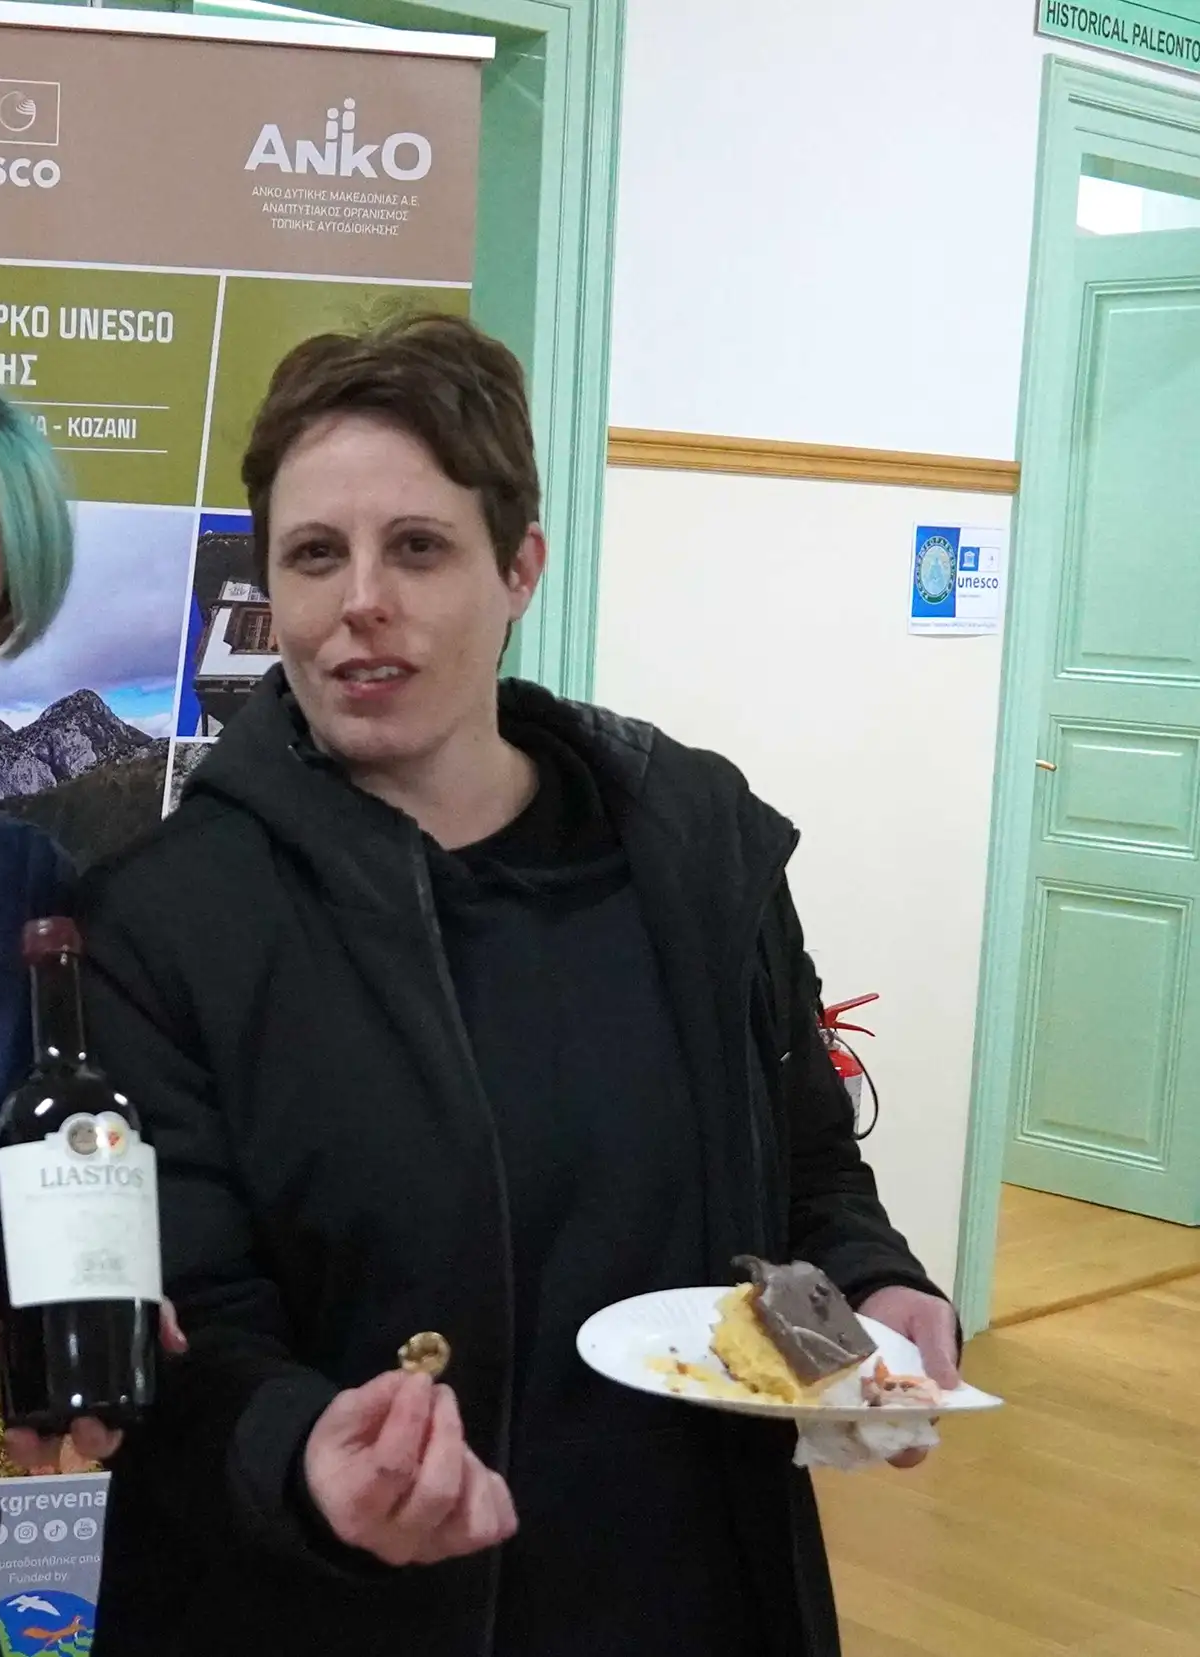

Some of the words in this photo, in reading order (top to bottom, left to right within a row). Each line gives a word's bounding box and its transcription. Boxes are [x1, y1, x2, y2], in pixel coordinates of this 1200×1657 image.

[1046, 1, 1129, 44] HISTORICAL
[284, 188, 328, 201] ΔΥΤΙΚΗΣ
[330, 191, 398, 205] ΜΑΚΕΔΟΝΙΑΣ
[262, 203, 342, 217] ΑΝΑΠΤΥΞΙΑΚΟΣ
[343, 207, 409, 221] ΟΡΓΑΝΙΣΜΟΣ
[271, 218, 315, 231] ΤΟΠΙΚΗΣ
[318, 221, 399, 236] ΑΥΤΟΔΙΟΙΚΗΣΗΣ
[59, 307, 174, 344] UNESCO
[68, 417, 137, 439] KOZANI
[958, 576, 999, 589] unesco
[40, 1165, 144, 1188] LIASTOS
[8, 1572, 51, 1584] Funded
[54, 1571, 68, 1583] by
